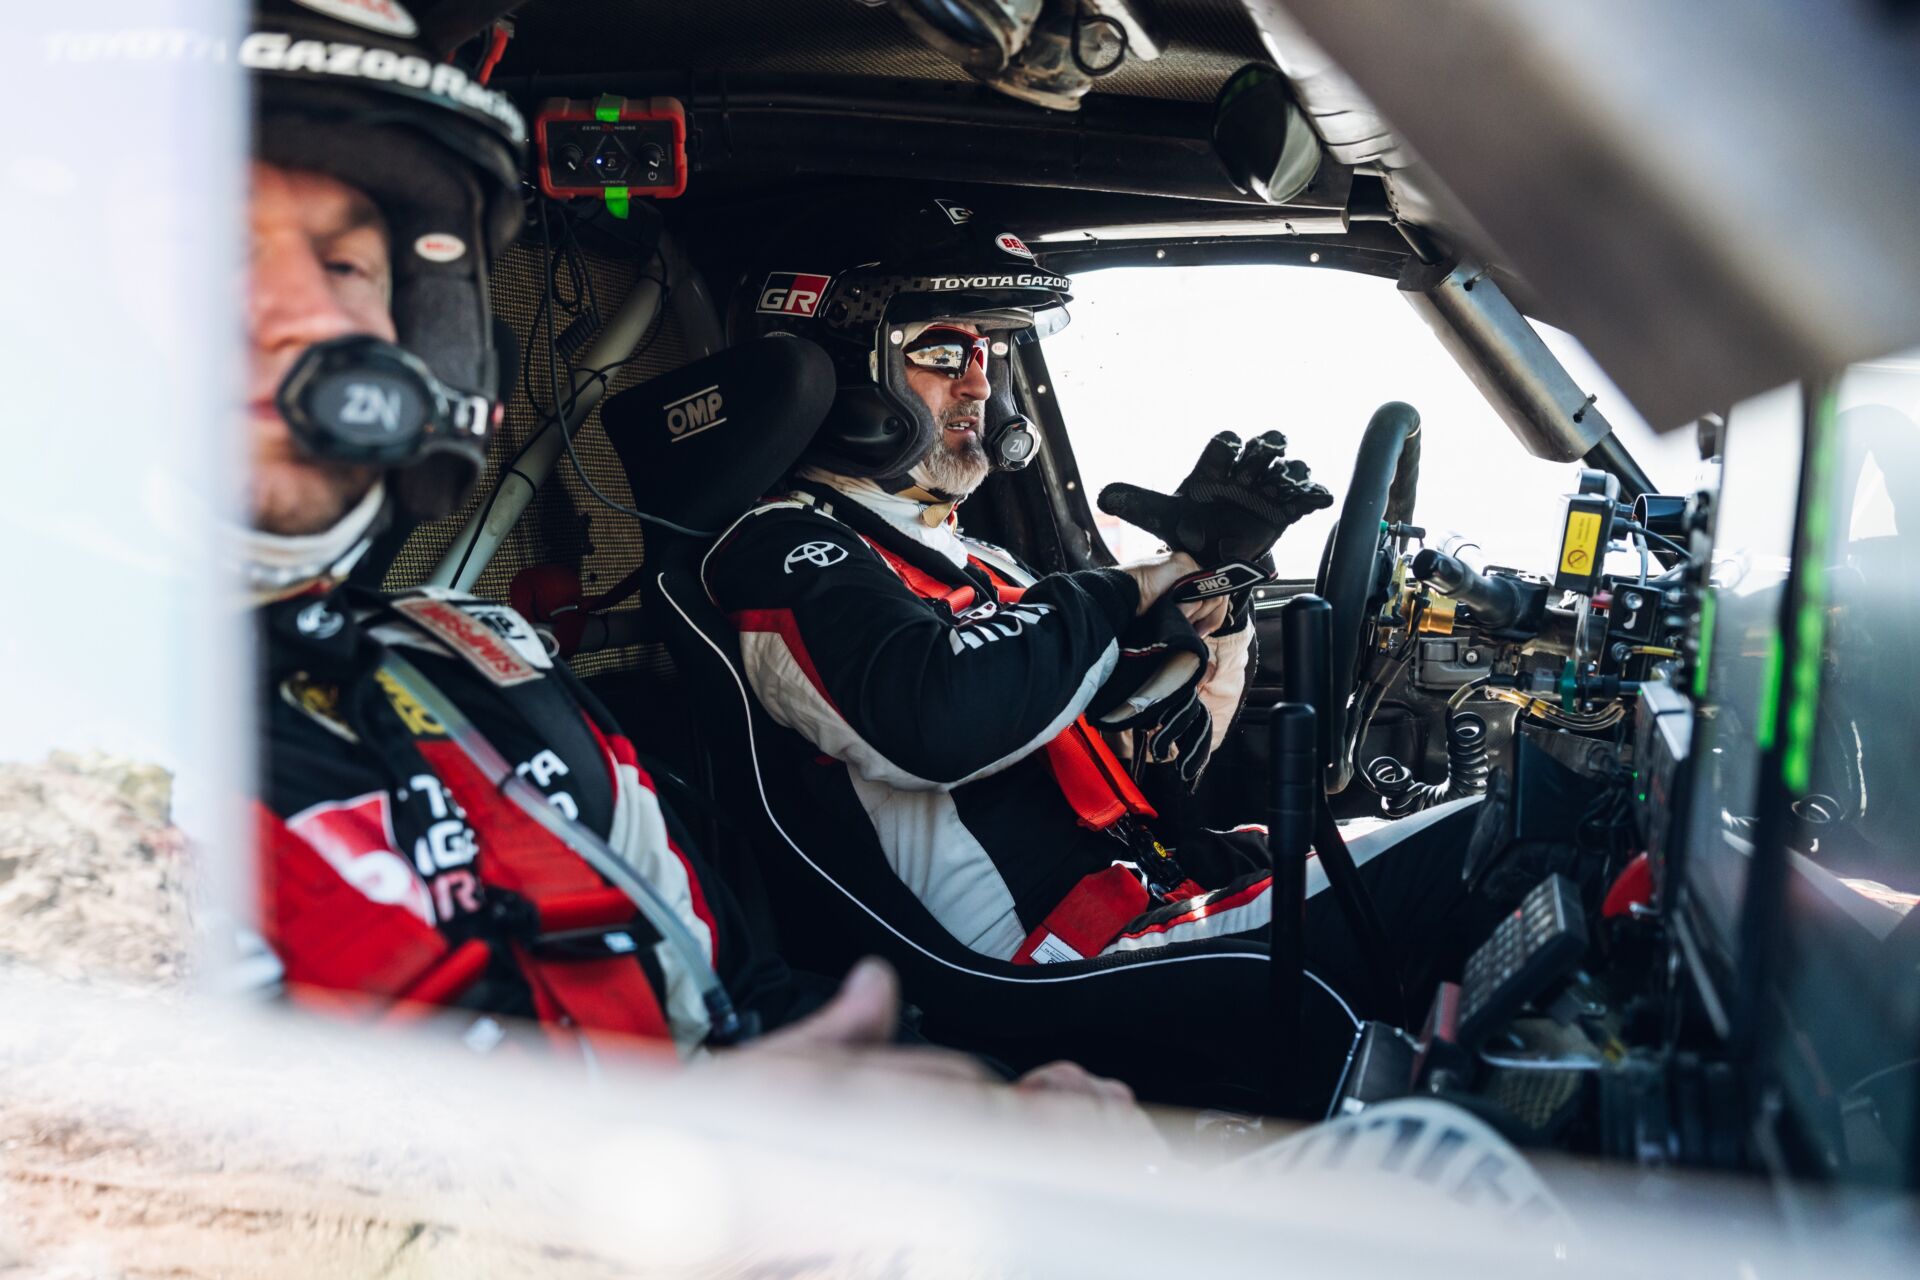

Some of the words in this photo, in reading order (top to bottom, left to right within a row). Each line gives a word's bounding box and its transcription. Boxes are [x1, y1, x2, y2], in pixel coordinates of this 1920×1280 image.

[238, 32, 431, 88] GAZOO
[949, 207, 974, 220] G
[930, 276, 1012, 290] TOYOTA
[1016, 274, 1068, 288] GAZOO
[760, 288, 818, 313] GR
[340, 382, 402, 432] ZN
[667, 392, 723, 435] OMP
[1010, 439, 1027, 455] ZN
[1197, 576, 1230, 591] OMP
